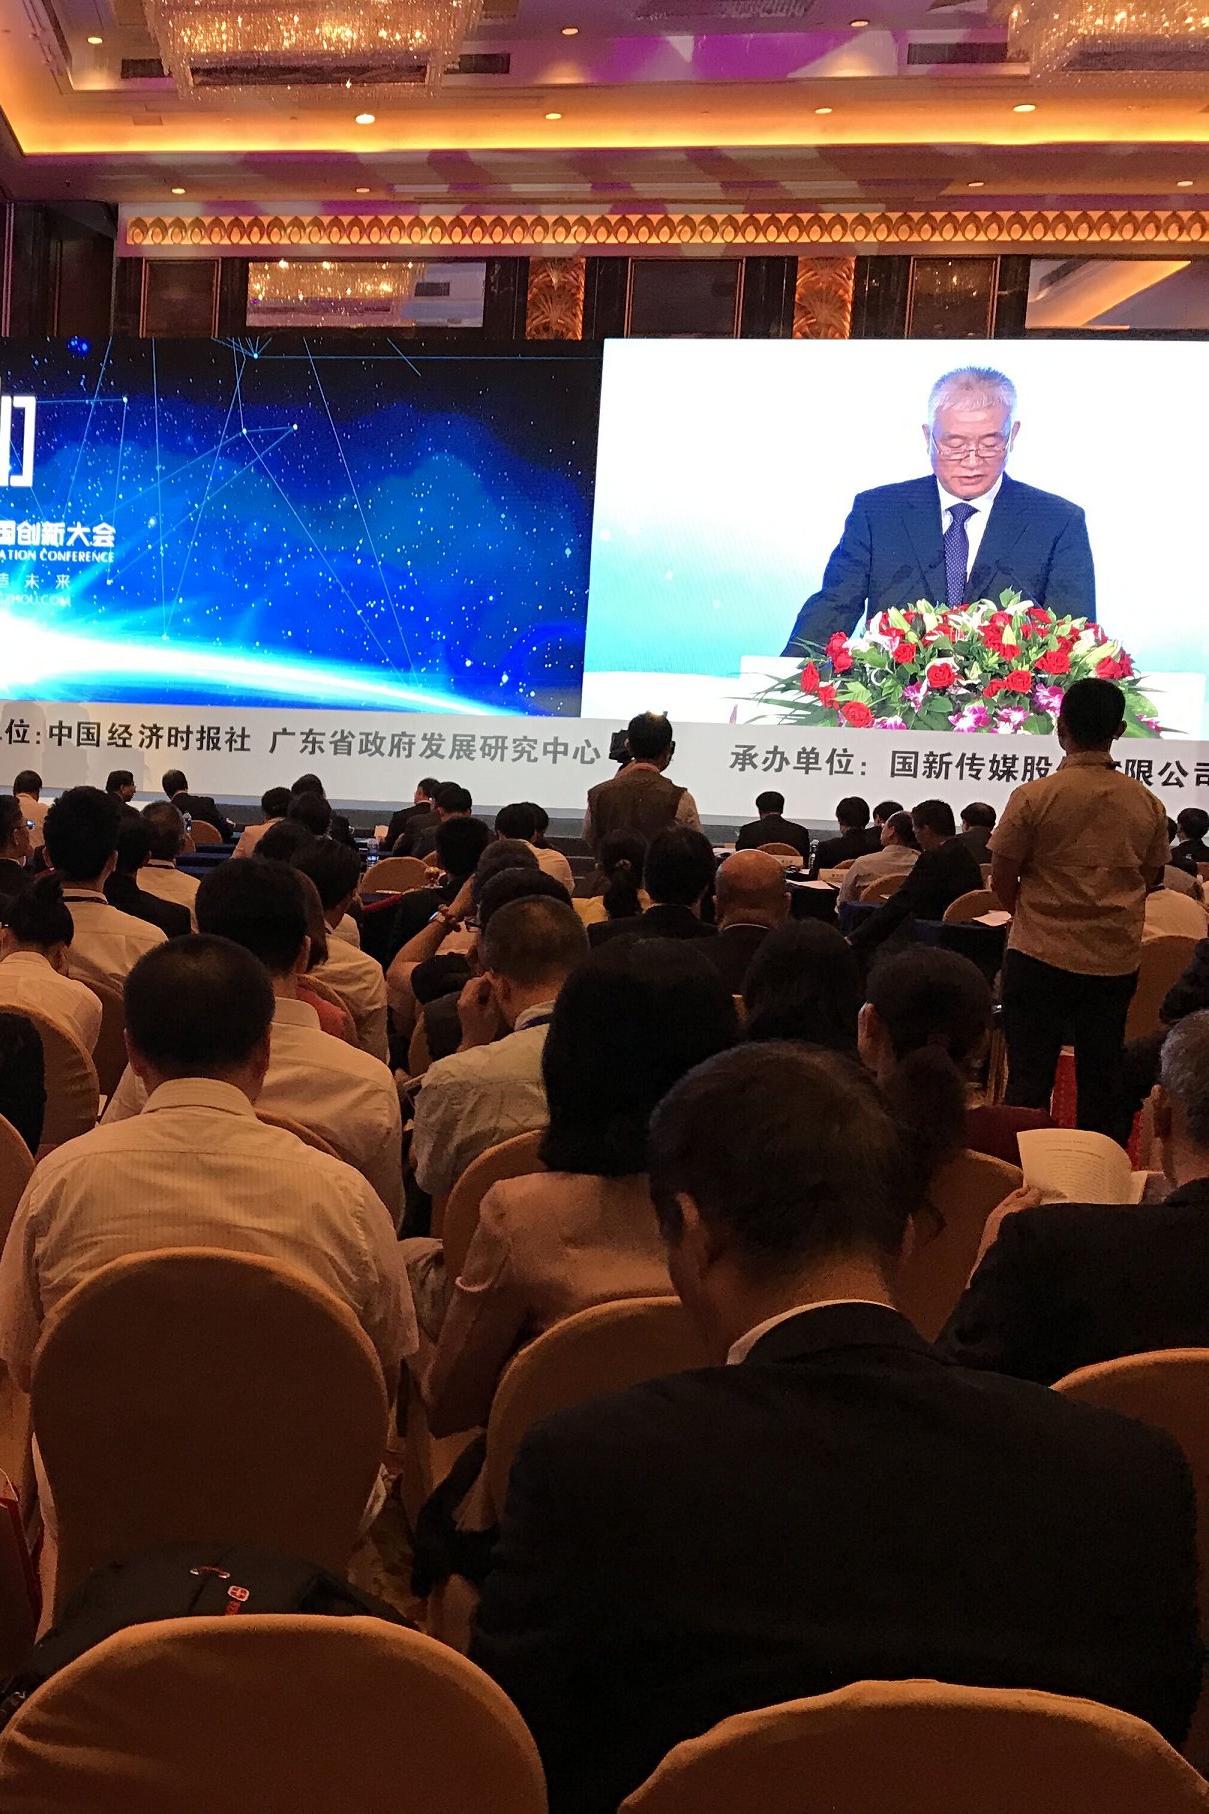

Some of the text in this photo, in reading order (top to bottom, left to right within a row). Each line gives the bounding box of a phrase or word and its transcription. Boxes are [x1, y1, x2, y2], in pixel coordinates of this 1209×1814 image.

[40, 550, 115, 563] CONFERENCE
[268, 727, 601, 765] 广东省政府发展研究中心
[890, 750, 1209, 788] 国新传媒股限公司
